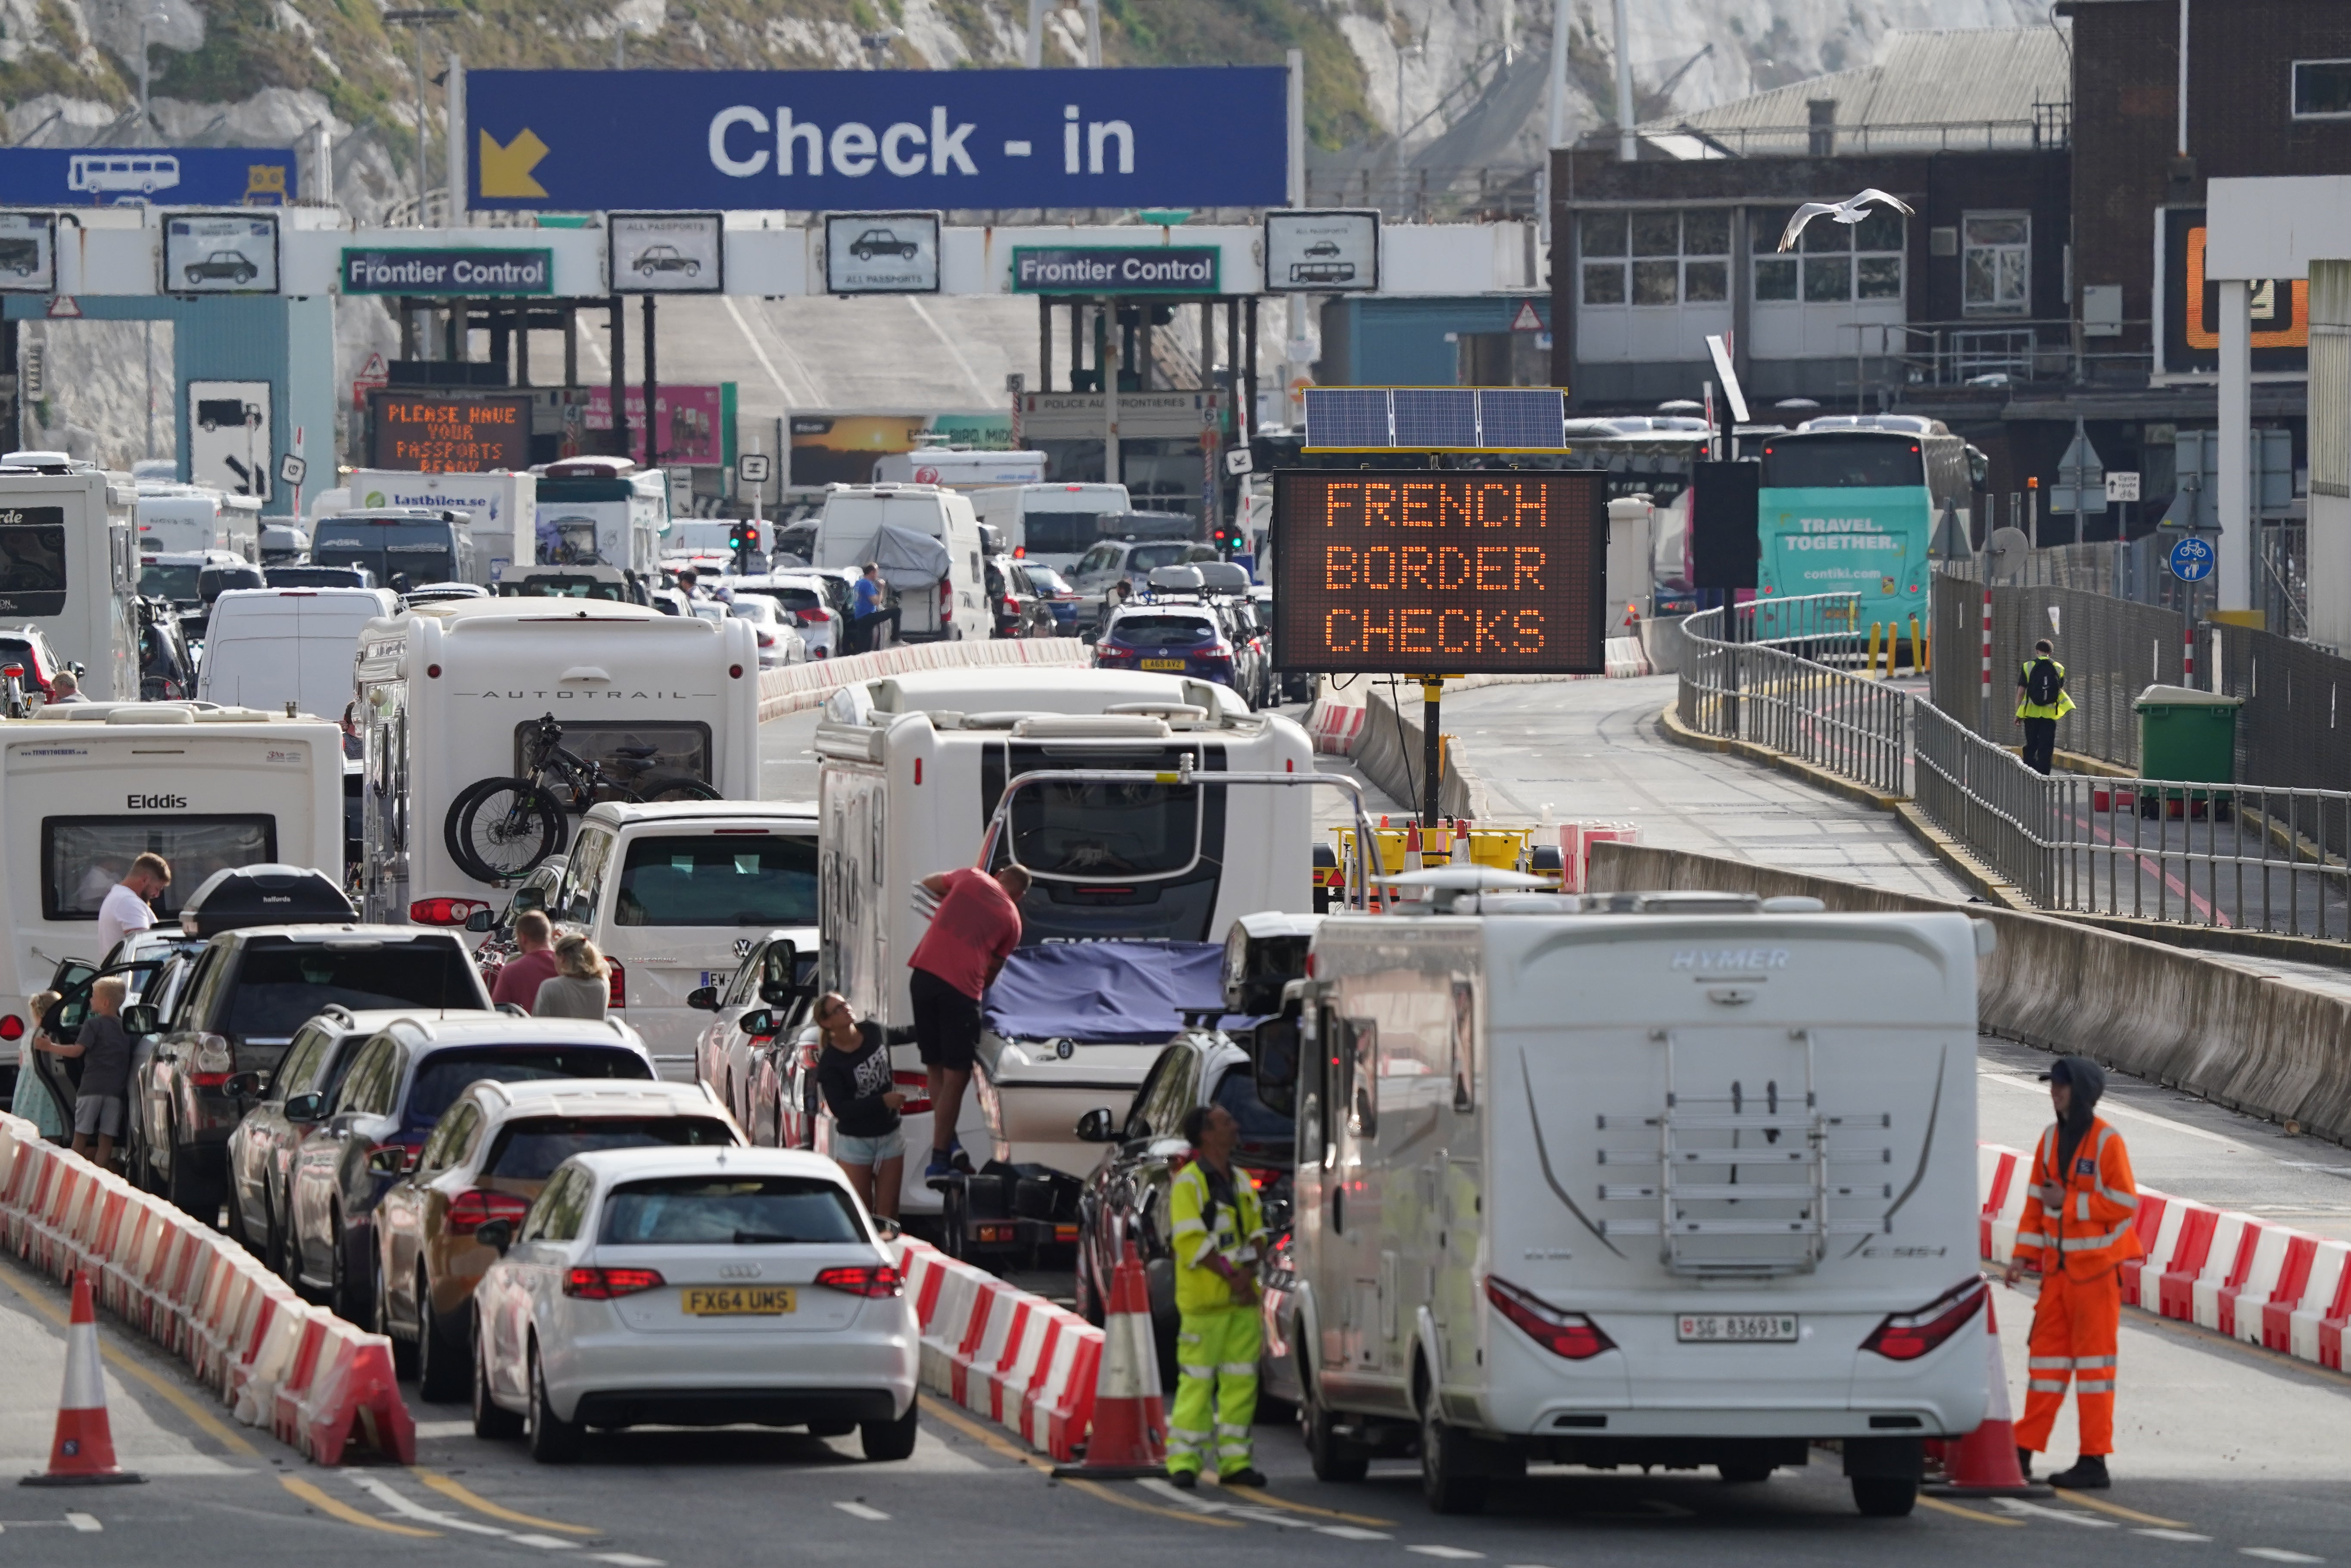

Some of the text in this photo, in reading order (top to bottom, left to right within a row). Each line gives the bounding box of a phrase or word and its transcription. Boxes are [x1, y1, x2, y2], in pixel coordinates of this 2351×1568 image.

[708, 105, 979, 177] Check
[1063, 104, 1135, 174] in
[627, 222, 705, 231] ALL PASSPORTS
[350, 259, 544, 284] Frontier Control
[846, 275, 923, 283] ALL PASSPORTS
[1021, 258, 1212, 281] Frontier Control
[1044, 399, 1085, 408] POLICE
[1089, 398, 1104, 408] AU
[388, 404, 516, 424] PLEASE HAVE
[427, 423, 474, 440] YOUR
[396, 441, 503, 460] PASSPORTS
[1327, 483, 1547, 528] FRENCH
[1800, 518, 1883, 533] TRAVEL.
[1785, 535, 1899, 551] TOGETHER.
[1326, 546, 1546, 591] BORDER
[1804, 567, 1881, 580] contiki.com
[1325, 608, 1545, 653] CHECKS
[128, 794, 187, 809] Elddis
[1670, 949, 1790, 970] HYMER
[691, 1291, 789, 1310] FX64 UMS
